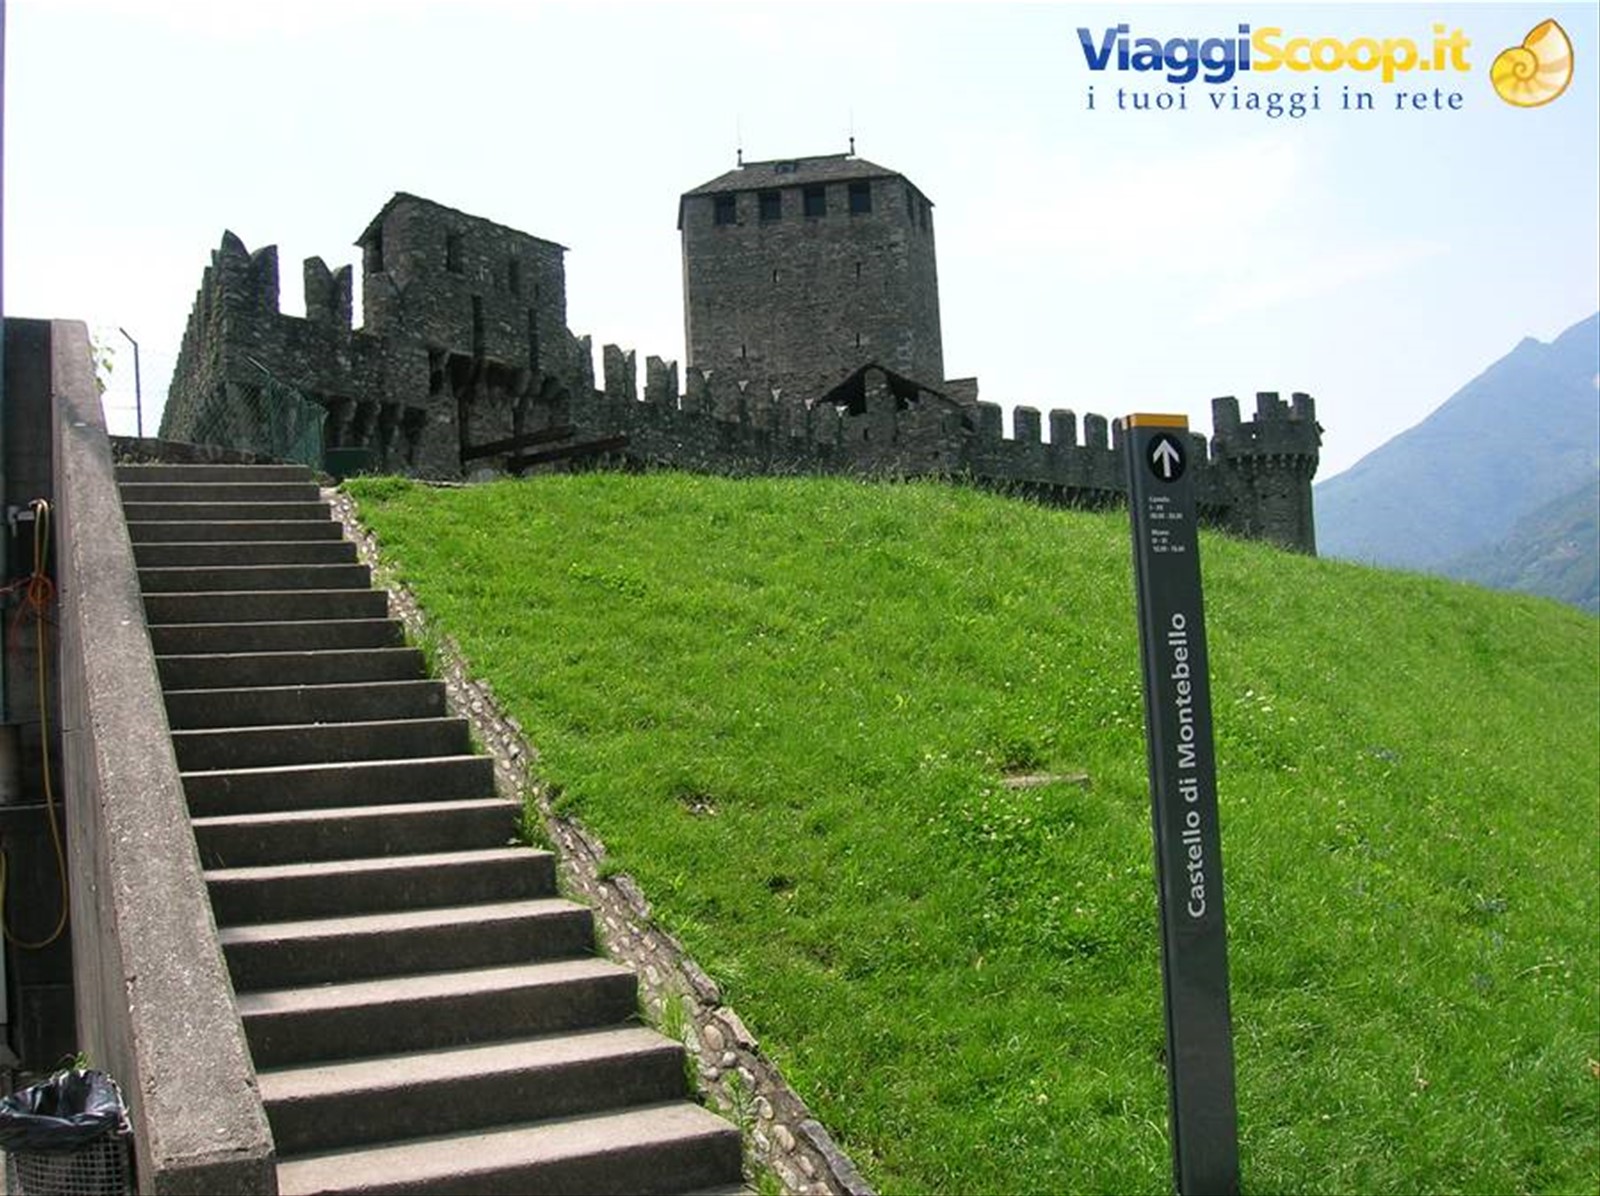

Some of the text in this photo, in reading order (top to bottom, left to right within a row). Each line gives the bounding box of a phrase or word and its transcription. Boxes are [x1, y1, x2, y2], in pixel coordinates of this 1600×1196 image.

[1168, 612, 1206, 918] Castello di Montebello
